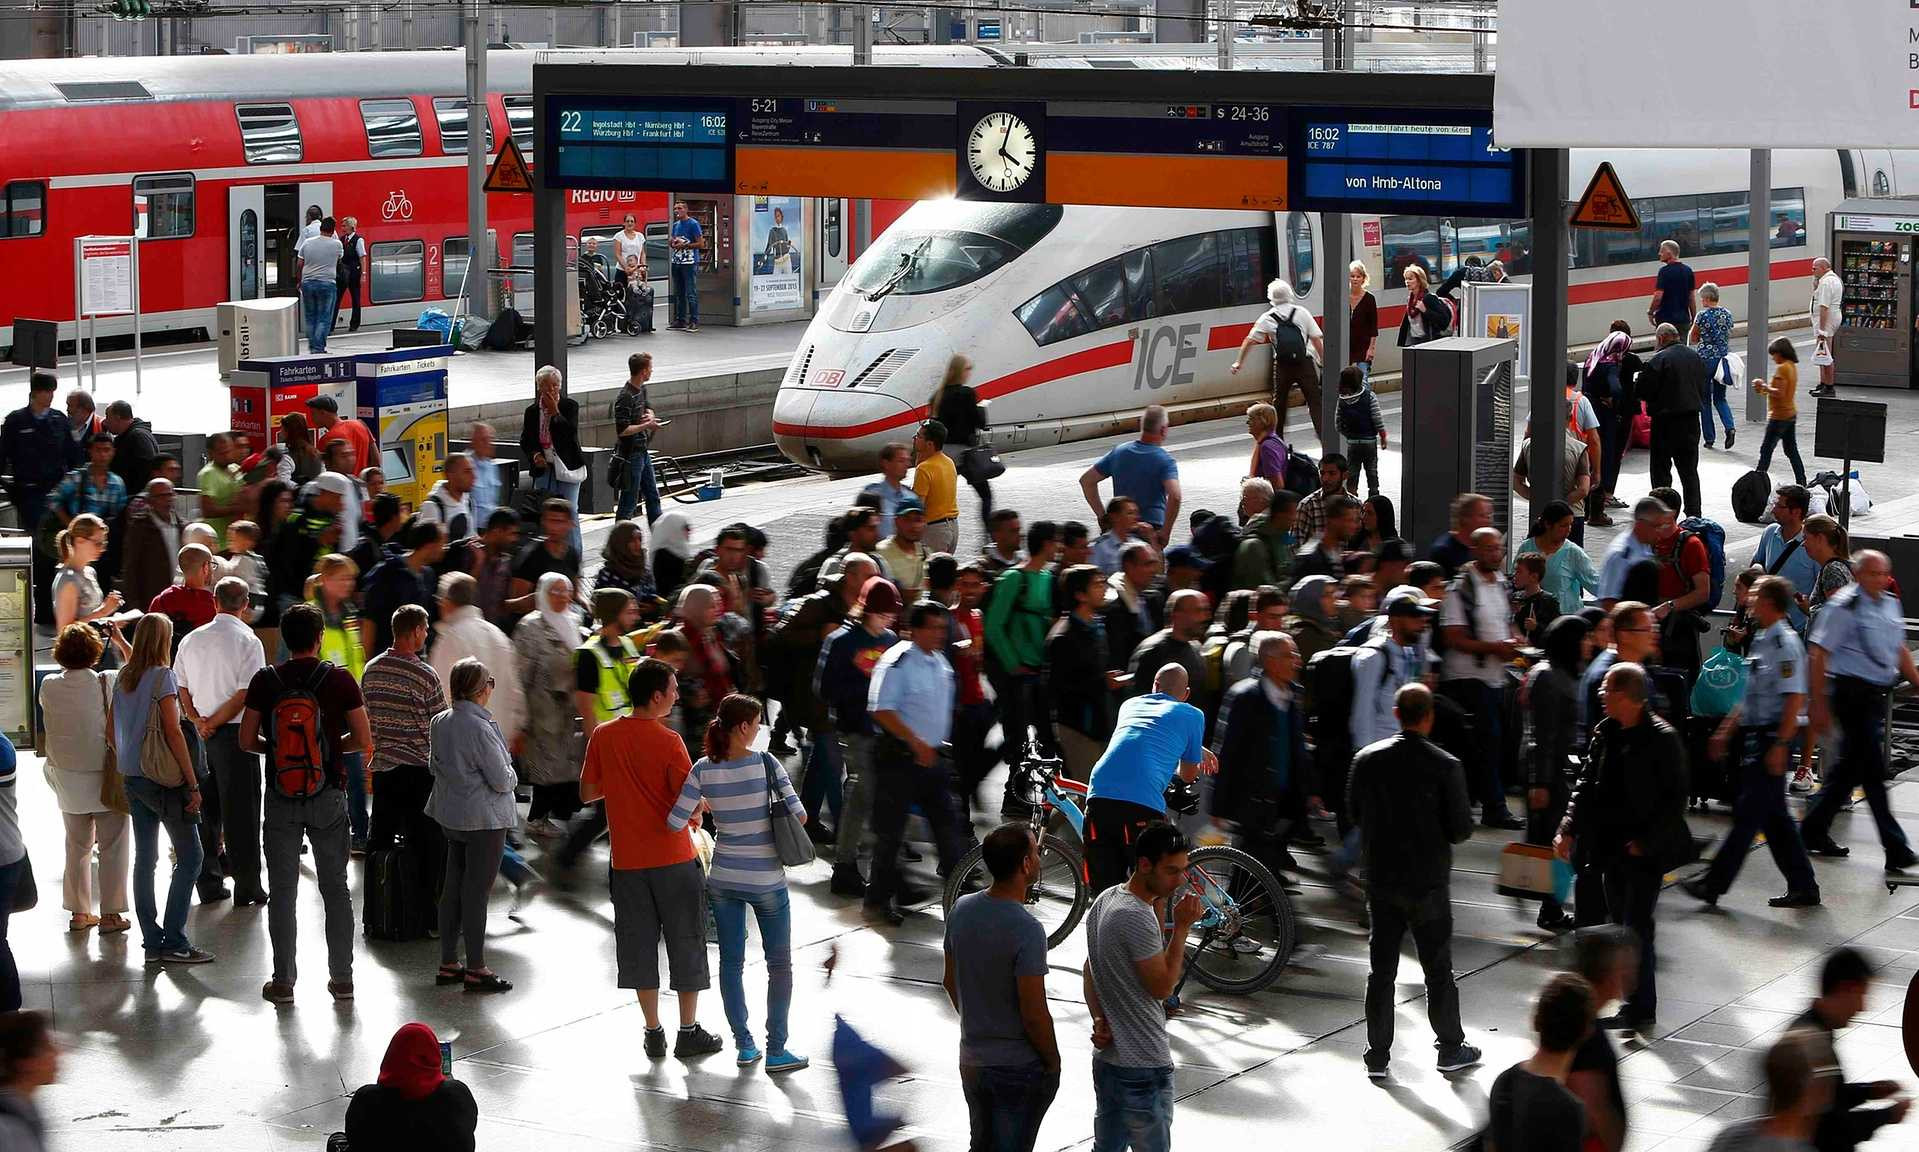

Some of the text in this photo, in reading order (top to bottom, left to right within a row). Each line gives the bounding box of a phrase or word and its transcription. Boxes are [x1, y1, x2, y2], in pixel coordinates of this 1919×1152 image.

[752, 99, 776, 112] 5-21
[1231, 106, 1269, 120] 24-36
[561, 111, 581, 132] 22
[700, 116, 726, 128] 16:02
[1308, 127, 1340, 141] 16:02
[1307, 141, 1335, 150] ICE 787
[1346, 176, 1442, 191] von Hmb-Altona
[571, 190, 616, 203] REGIO
[429, 246, 438, 265] 2
[1133, 323, 1202, 390] ICE
[279, 366, 317, 377] Fahrkarten
[380, 365, 411, 374] Fahrkarten
[812, 370, 843, 386] DB
[231, 419, 261, 430] Fahrkarten
